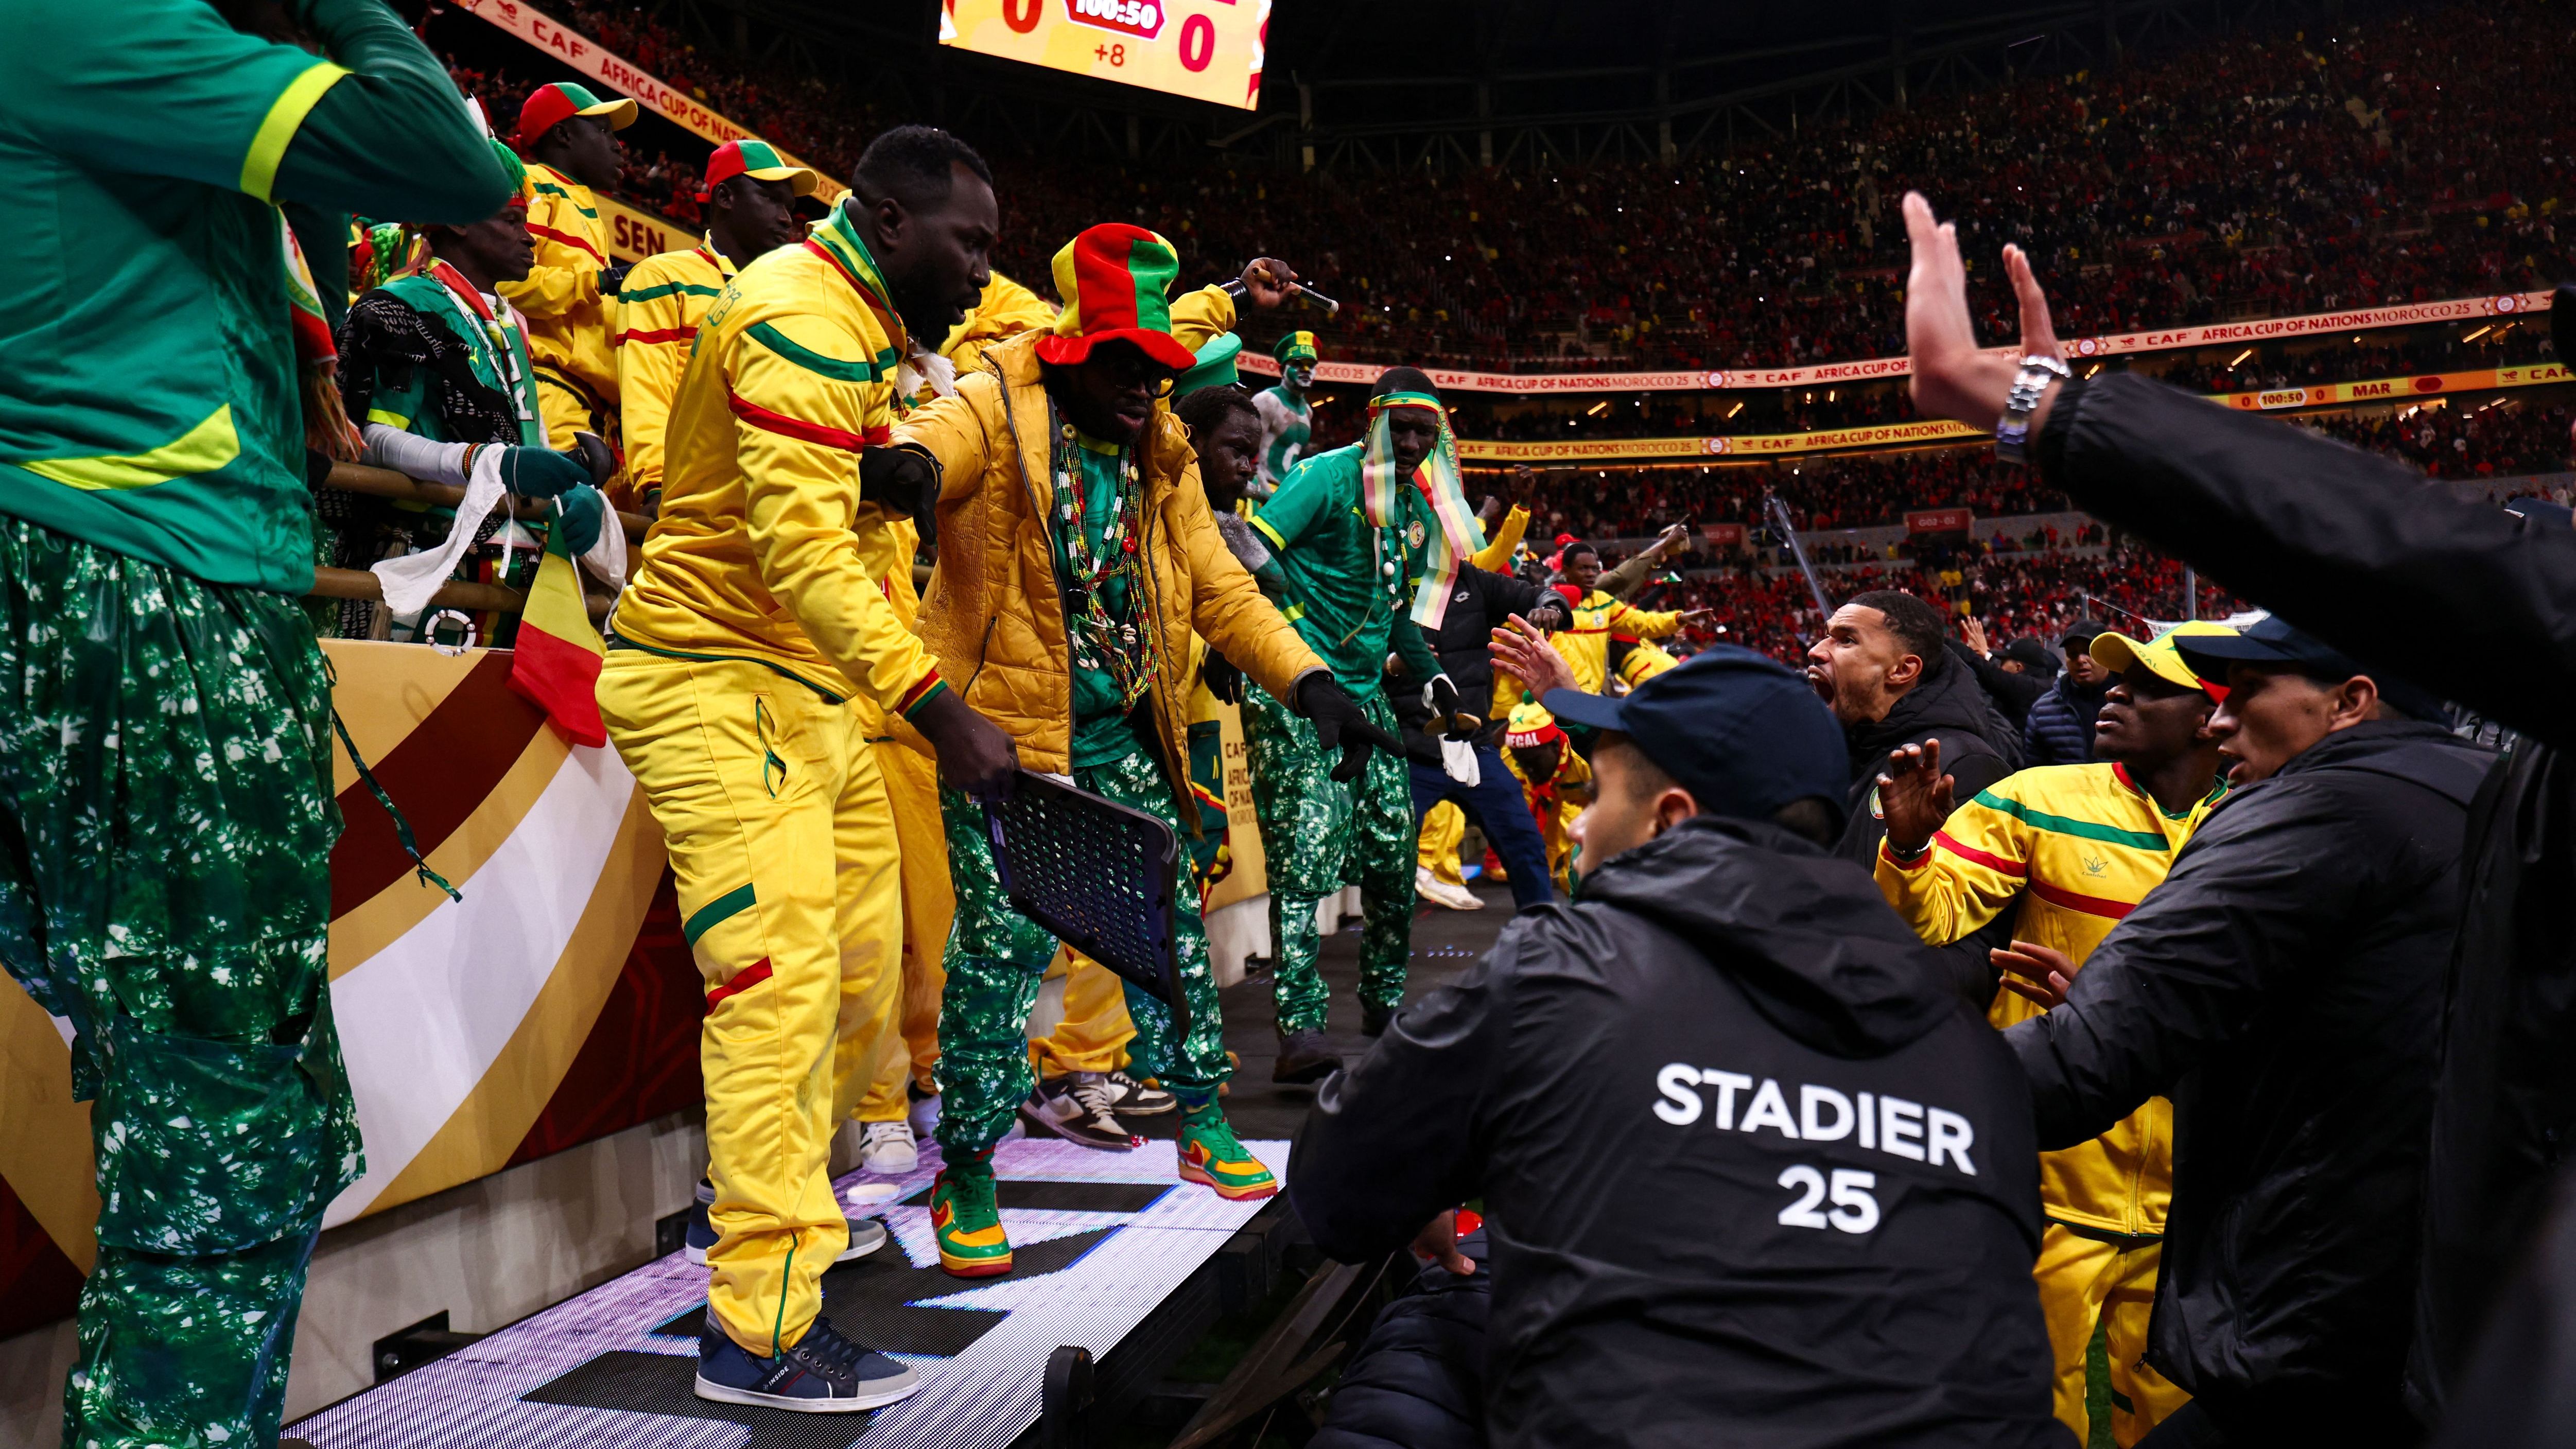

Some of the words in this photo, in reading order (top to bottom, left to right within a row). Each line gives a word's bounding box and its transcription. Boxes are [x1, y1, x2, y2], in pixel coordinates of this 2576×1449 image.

[1075, 0, 1157, 29] 100:50
[1179, 14, 1214, 73] 0
[1095, 44, 1124, 67] +8
[533, 20, 584, 58] CAF
[601, 58, 657, 105] AFRICA
[659, 91, 688, 119] CUP
[690, 108, 709, 131] OF
[615, 214, 665, 257] SEN
[2147, 333, 2187, 345] CAF
[2202, 326, 2253, 340] AFRICA
[2255, 323, 2284, 335] CUP
[2286, 320, 2305, 331] OF
[2308, 313, 2372, 330] NATIONS
[2374, 306, 2451, 323] MOROCCO
[2455, 304, 2470, 315] 25
[1249, 356, 1281, 372] NATIO
[1766, 372, 1802, 383] CAF
[1815, 366, 1861, 379] AFRICA
[1863, 363, 1888, 375] CUP
[1891, 361, 1908, 372] OF
[2530, 368, 2570, 380] CAF
[1435, 375, 1467, 385] CAF
[1477, 377, 1512, 389] AFRICA
[1515, 379, 1537, 390] CUP
[1540, 378, 1556, 389] OF
[1559, 377, 1610, 388] NATIONS
[1612, 376, 1674, 387] MOROCCO
[1677, 376, 1689, 386] 25
[2241, 396, 2251, 407] 0
[2262, 392, 2303, 405] 100:50
[2316, 390, 2325, 400] 0
[2353, 382, 2391, 397] MAR
[1762, 439, 1794, 449] CAF
[1806, 433, 1848, 446] AFRICA
[1850, 430, 1873, 443] CUP
[1875, 429, 1890, 440] OF
[1893, 425, 1944, 439] NATIONS
[1458, 445, 1485, 454] CAF
[1495, 445, 1529, 457] AFRICA
[1531, 445, 1553, 457] CUP
[1555, 445, 1570, 456] OF
[1572, 444, 1620, 455] NATIONS
[1622, 443, 1678, 454] MOROCCO
[1680, 442, 1692, 452] 25
[1652, 1062, 1977, 1176] STADIER
[1777, 1164, 1881, 1234] 25
[769, 1366, 789, 1387] INSIDE
